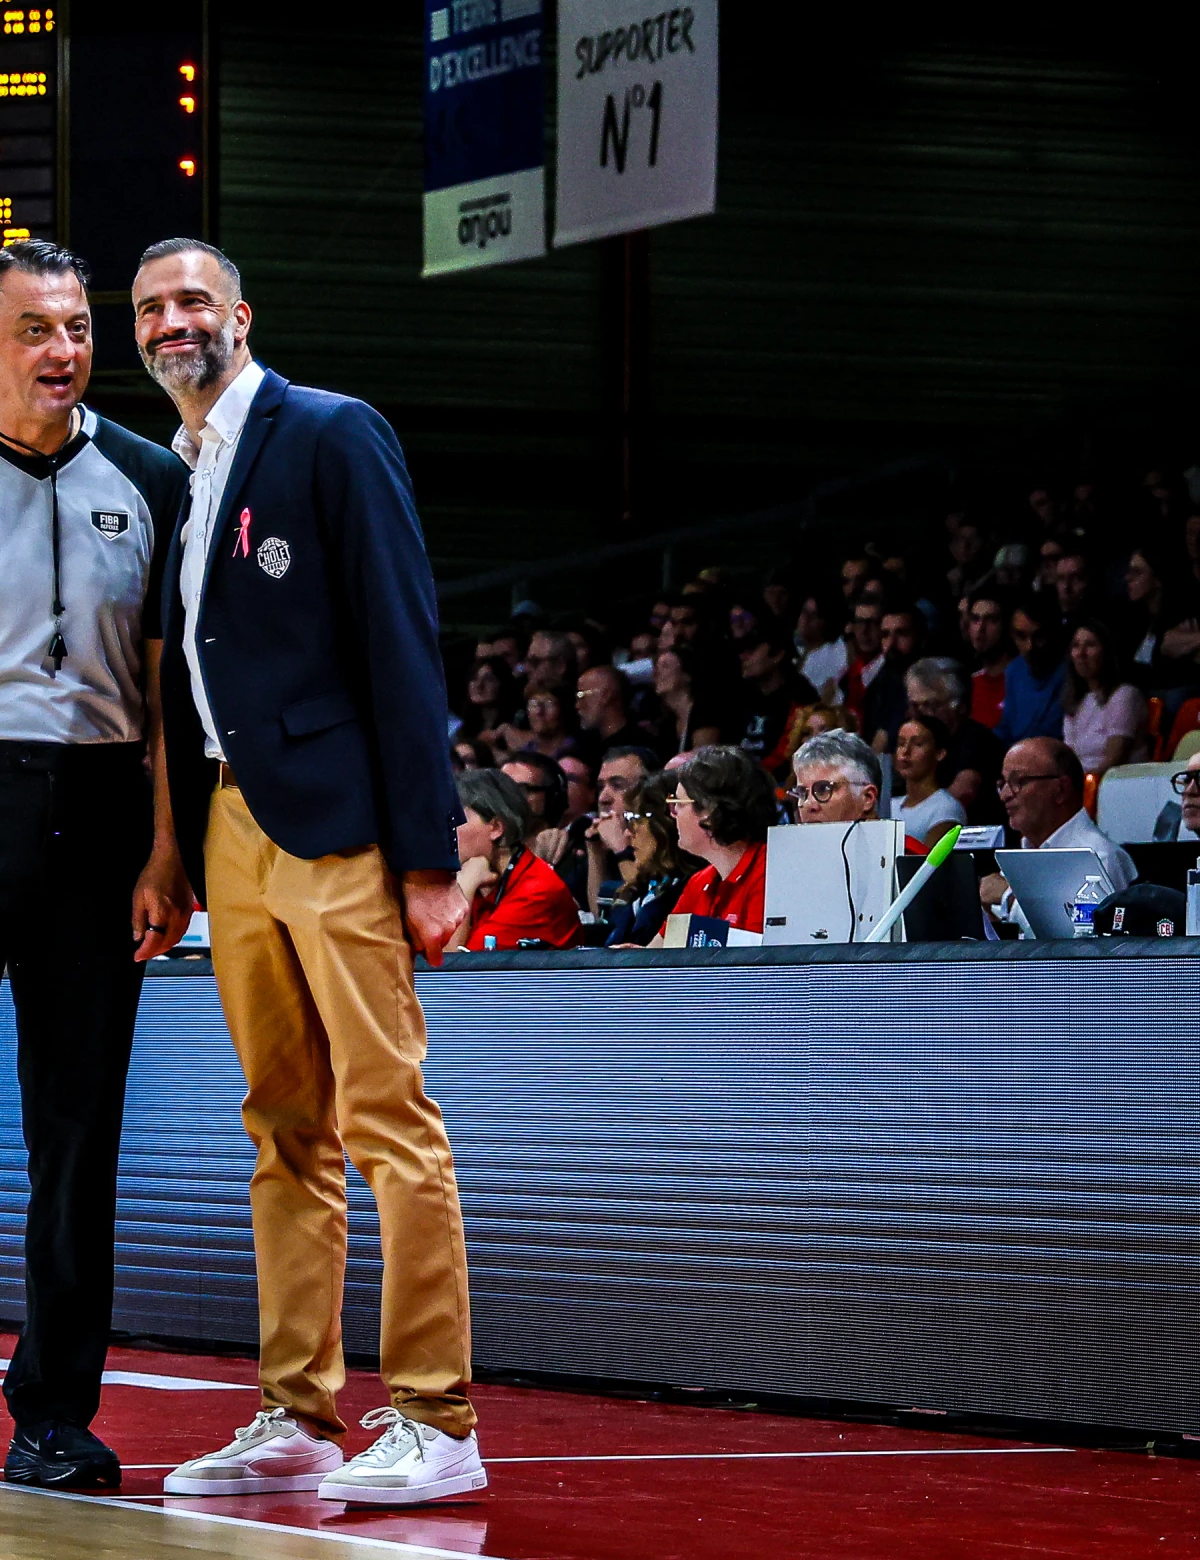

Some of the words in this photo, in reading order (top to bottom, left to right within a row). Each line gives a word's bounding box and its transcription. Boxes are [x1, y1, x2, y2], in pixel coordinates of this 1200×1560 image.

[575, 7, 695, 80] SUPPORTER
[458, 207, 511, 249] anjou
[100, 514, 119, 525] FIBA
[257, 545, 290, 567] CHOLET
